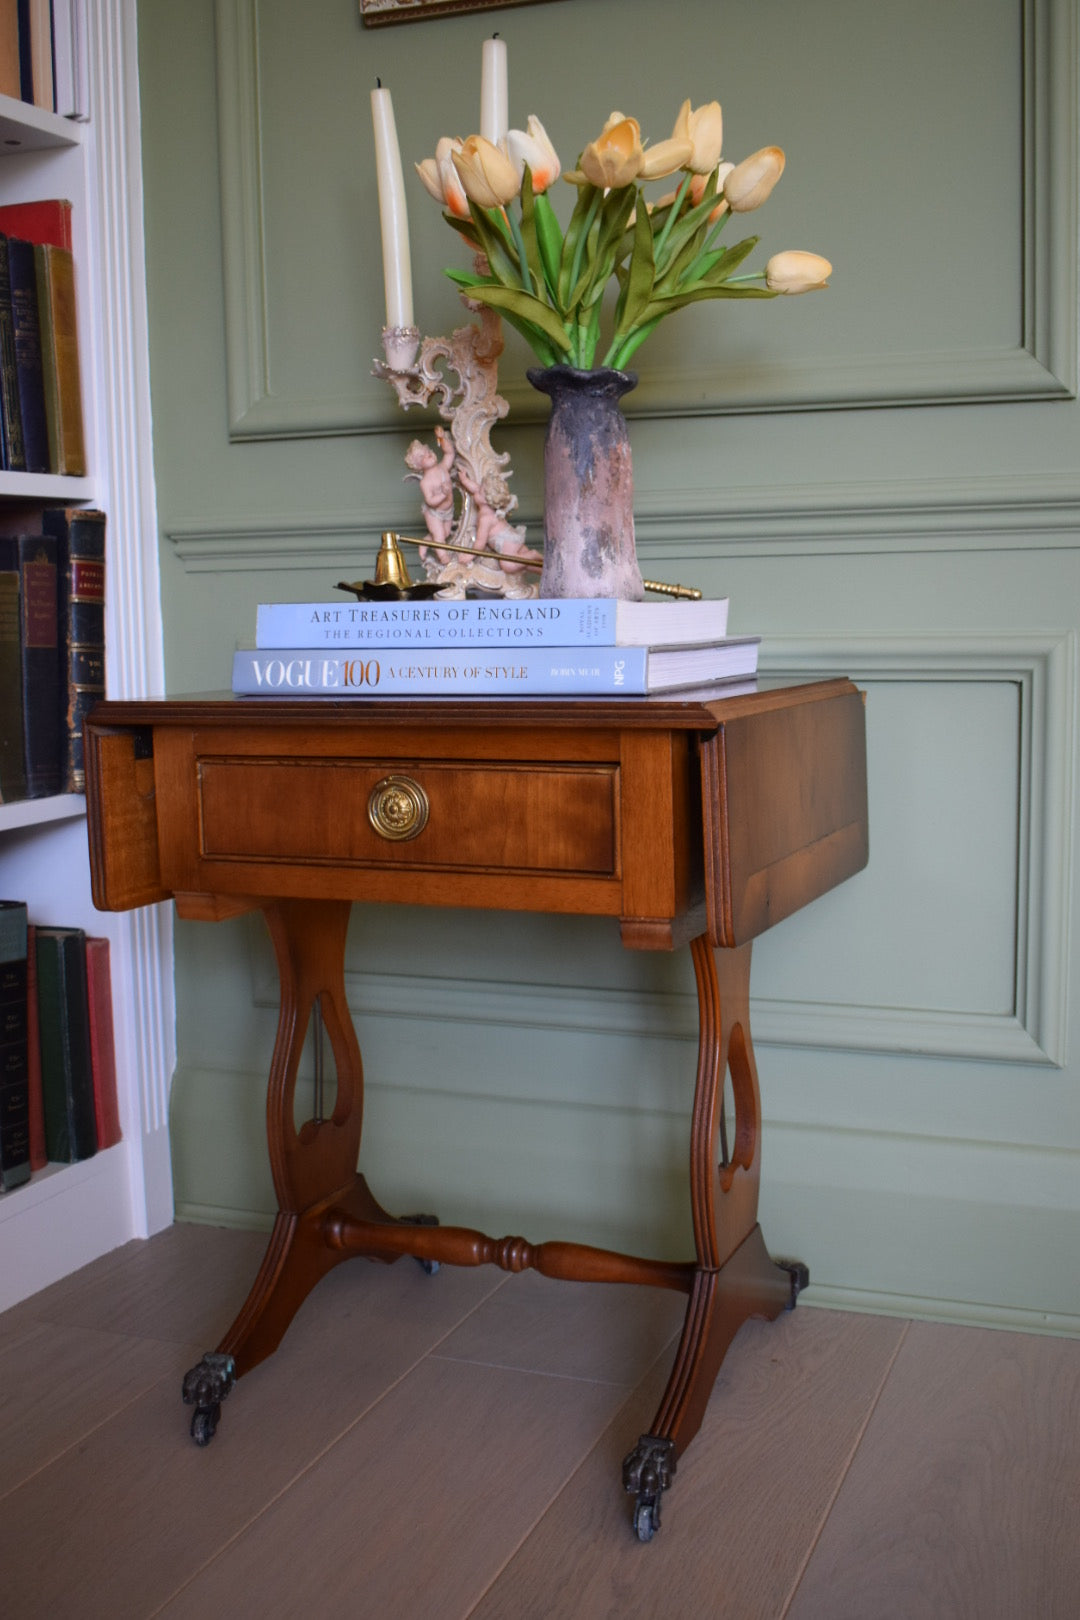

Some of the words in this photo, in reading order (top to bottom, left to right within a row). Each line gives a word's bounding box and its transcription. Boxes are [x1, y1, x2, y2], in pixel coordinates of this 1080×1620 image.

[310, 610, 342, 623] ART
[348, 609, 440, 622] TREASURES
[447, 608, 470, 621] OF
[477, 606, 561, 621] ENGLAND
[324, 629, 351, 639] THE
[357, 628, 431, 639] REGIONAL
[438, 627, 544, 638] COLLECTIONS
[252, 659, 339, 688] VOGUE
[341, 659, 381, 688] 100
[388, 667, 396, 678] A
[399, 666, 458, 679] CENTURY
[463, 666, 483, 679] OF
[484, 666, 528, 679] STYLE
[613, 660, 625, 686] NPG
